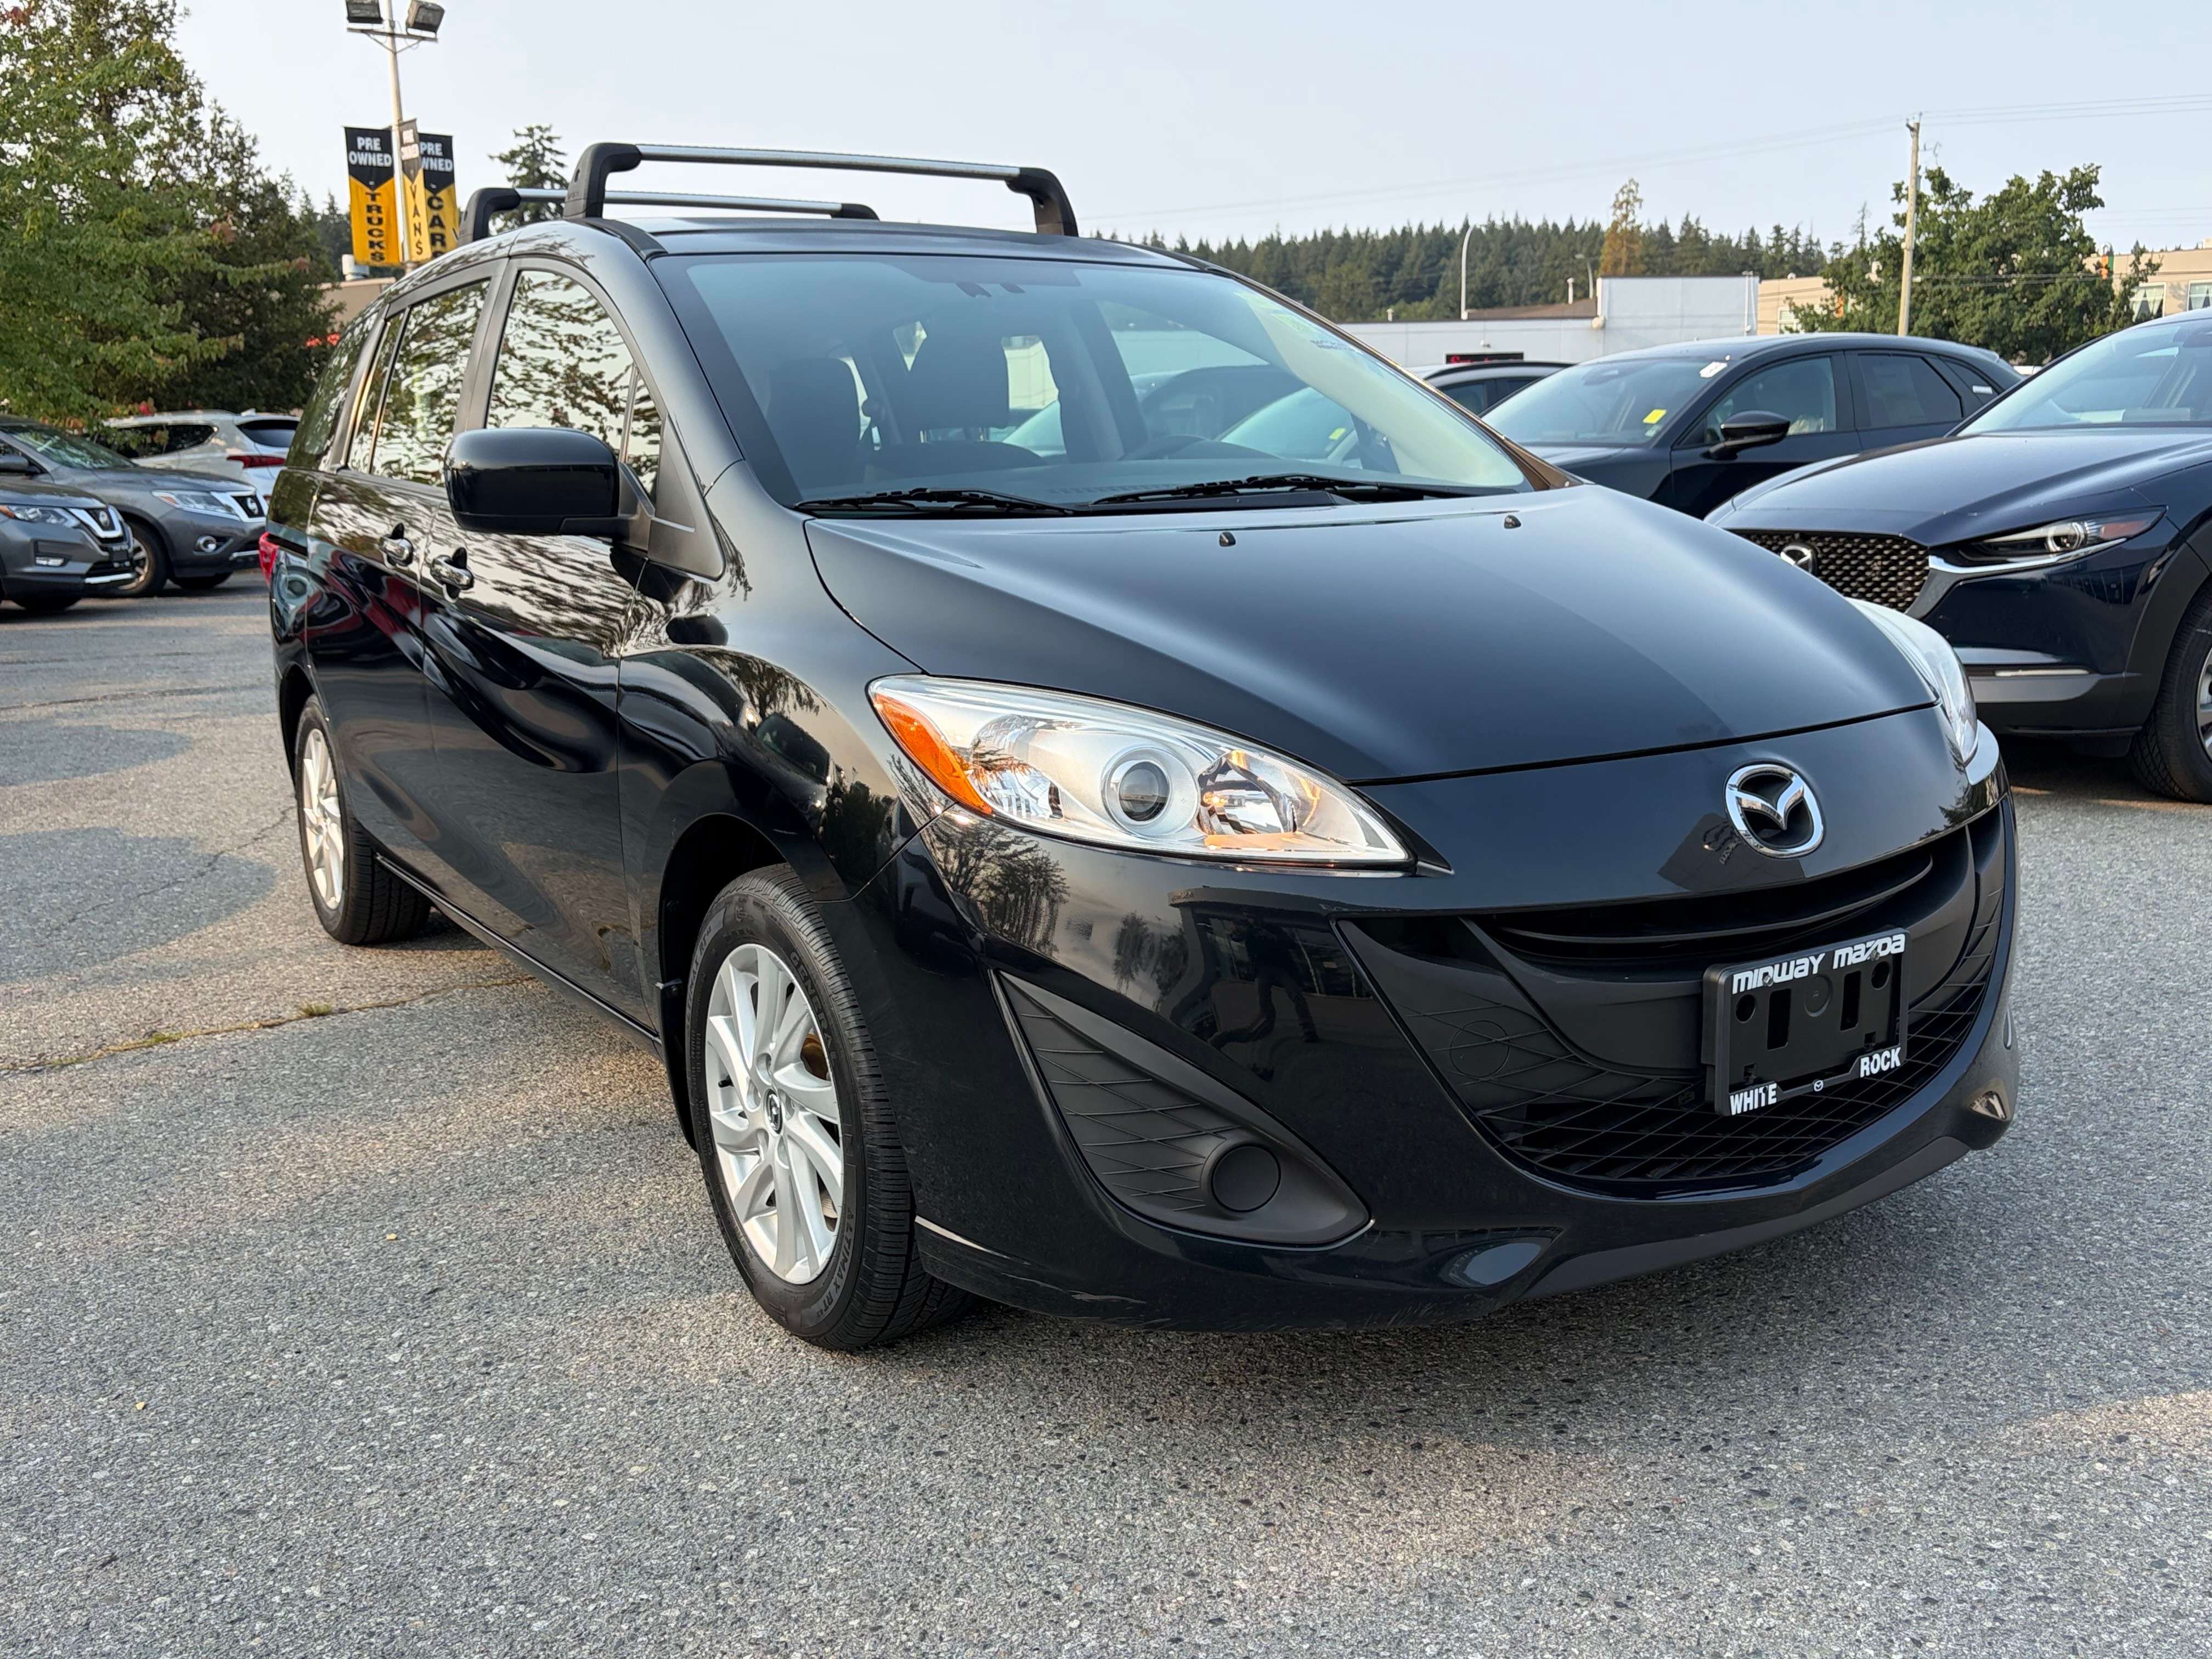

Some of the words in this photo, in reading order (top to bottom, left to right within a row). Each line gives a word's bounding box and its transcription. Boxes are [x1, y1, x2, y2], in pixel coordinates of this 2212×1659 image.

[357, 136, 382, 151] PRE
[420, 141, 443, 156] PRE
[348, 152, 392, 167] OWNED
[421, 156, 453, 172] WNED
[365, 192, 386, 262] TRUCKS
[410, 184, 423, 255] VANS
[1729, 1082, 1778, 1116] WHITE
[1859, 1046, 1901, 1078] ROCK
